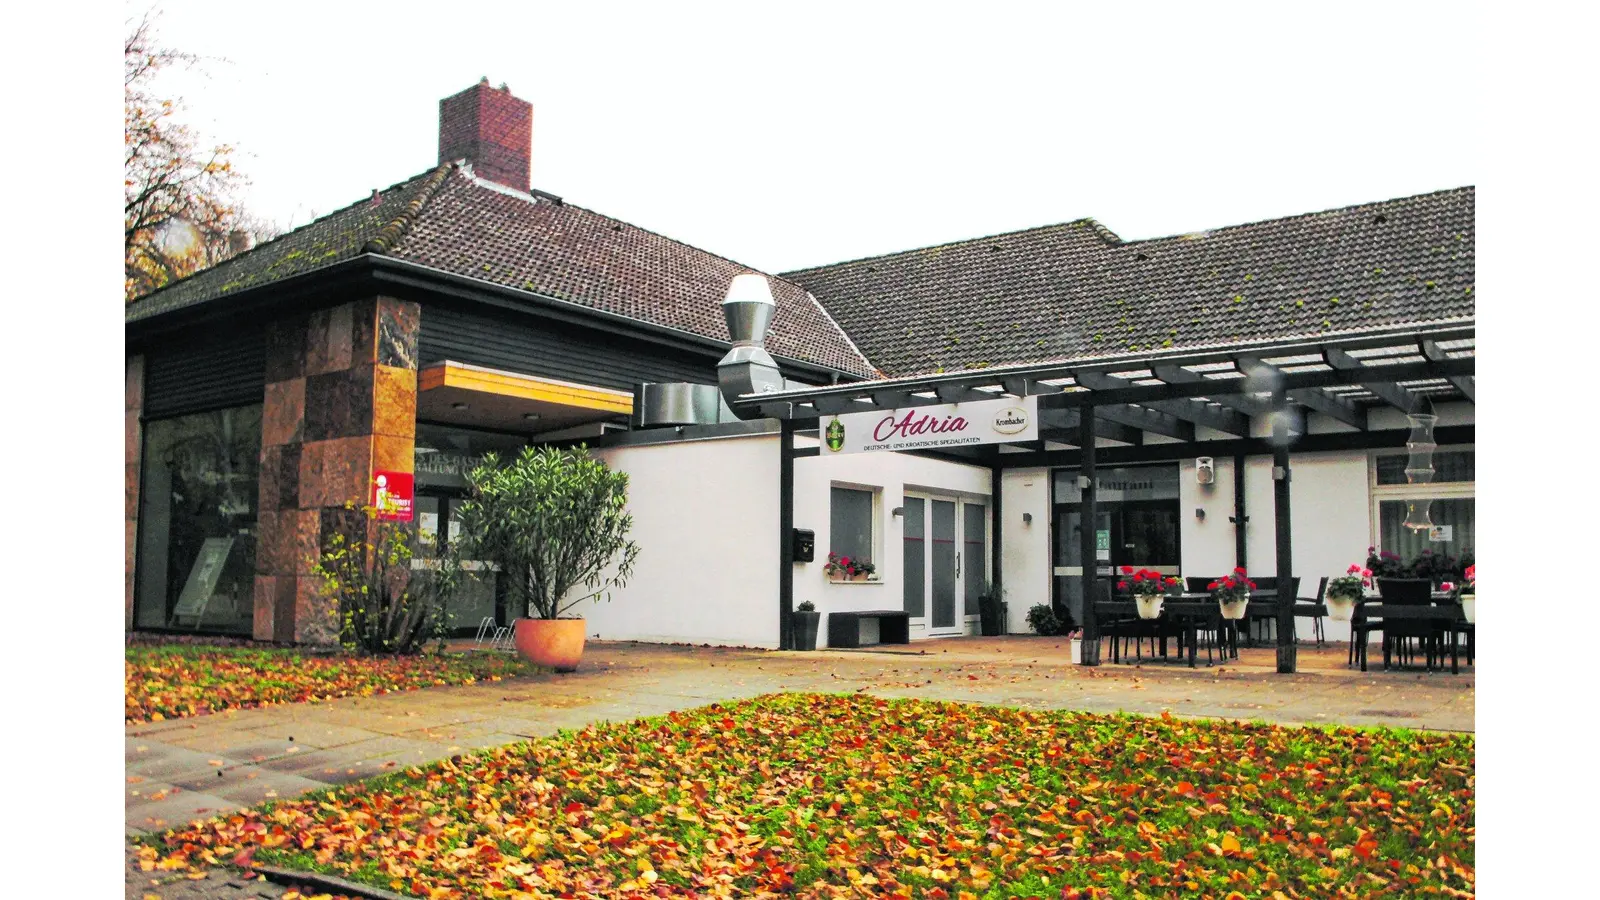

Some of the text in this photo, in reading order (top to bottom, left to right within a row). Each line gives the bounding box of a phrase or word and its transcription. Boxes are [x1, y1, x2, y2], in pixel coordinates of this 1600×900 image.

[873, 409, 969, 442] Adria
[996, 416, 1025, 426] Krombacher
[905, 440, 939, 448] KROATISCHE
